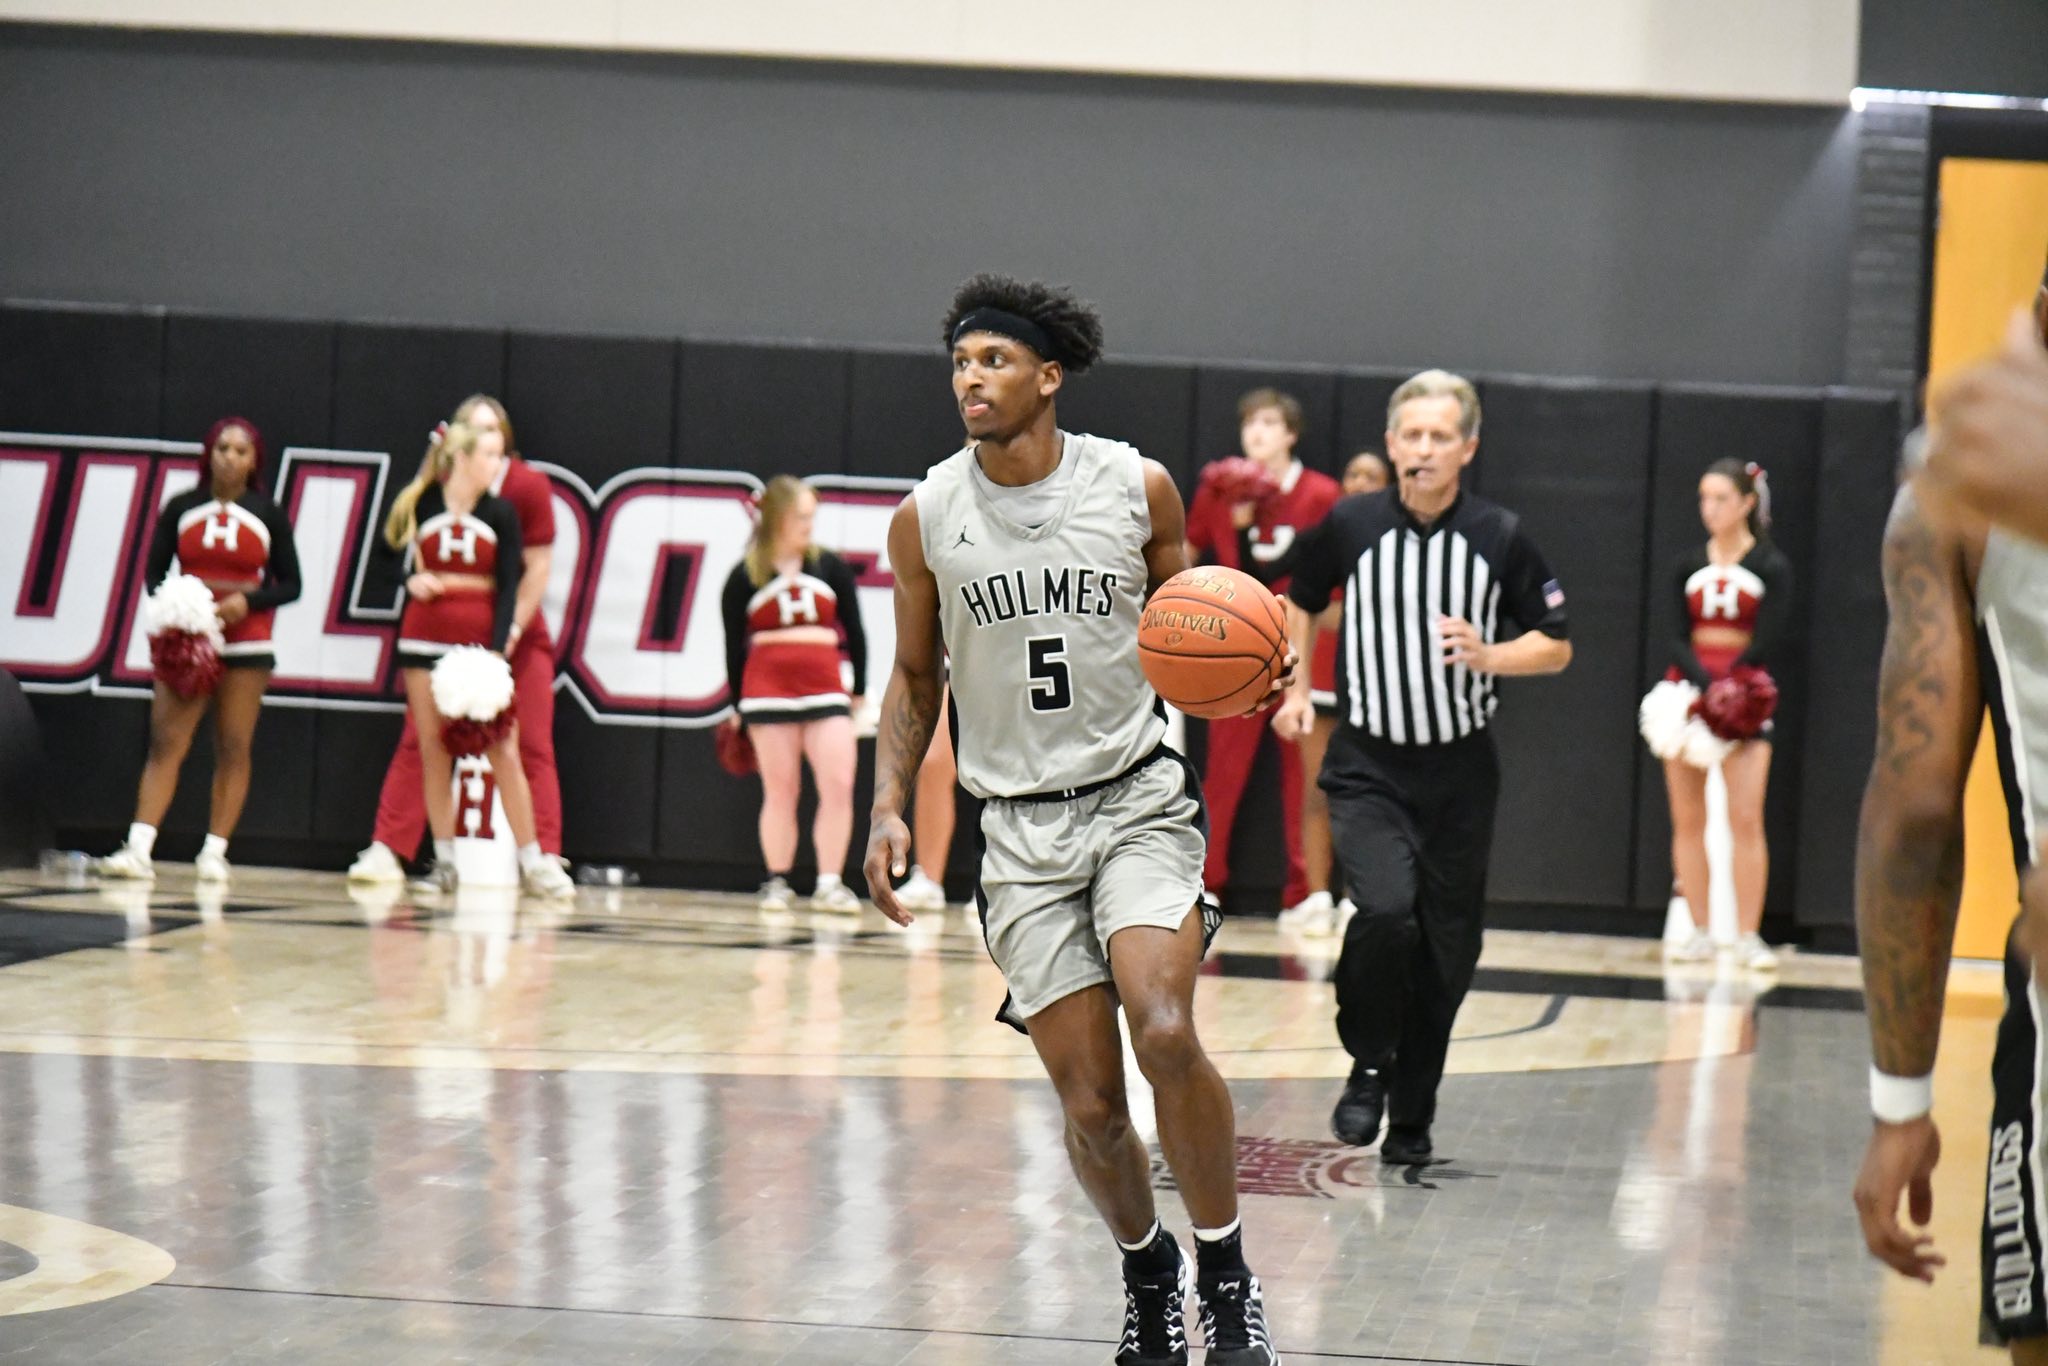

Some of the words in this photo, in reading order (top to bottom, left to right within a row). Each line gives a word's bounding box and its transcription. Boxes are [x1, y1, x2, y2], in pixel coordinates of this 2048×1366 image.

[202, 512, 240, 552] H
[438, 526, 477, 564] H
[776, 586, 818, 626] H
[959, 567, 1118, 628] HOLMES
[1701, 580, 1740, 619] H
[1141, 608, 1229, 641] SPALDING
[1025, 633, 1075, 715] 5
[455, 769, 497, 840] H
